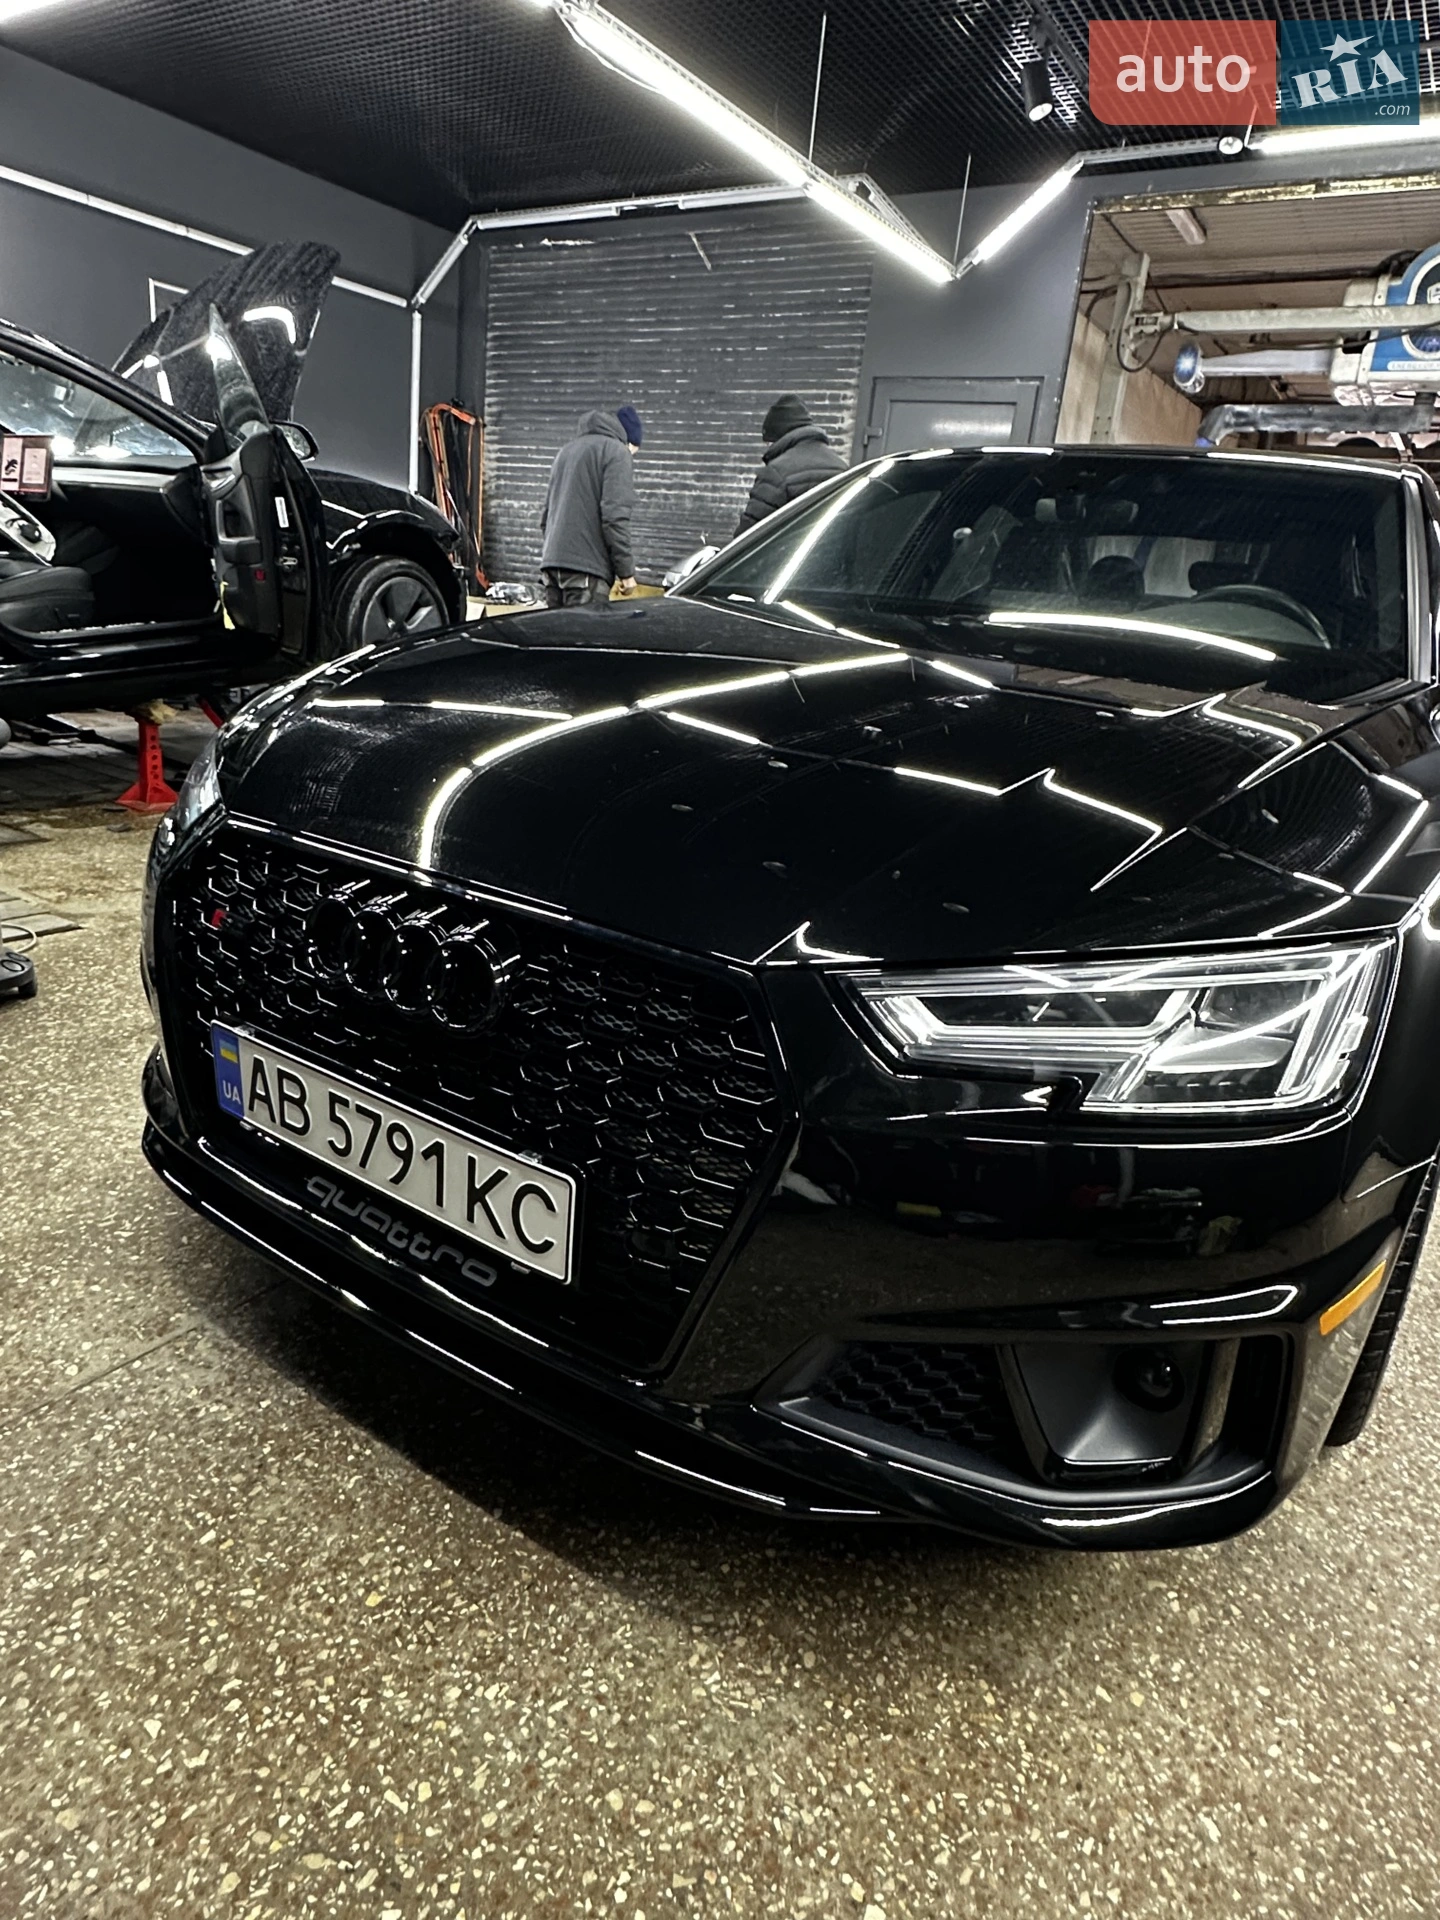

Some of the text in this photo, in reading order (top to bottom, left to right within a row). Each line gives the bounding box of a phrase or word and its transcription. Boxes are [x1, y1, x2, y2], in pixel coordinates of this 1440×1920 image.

[222, 1079, 242, 1105] UA
[248, 1054, 557, 1255] AB 5791 KC
[306, 1175, 498, 1288] quattro
